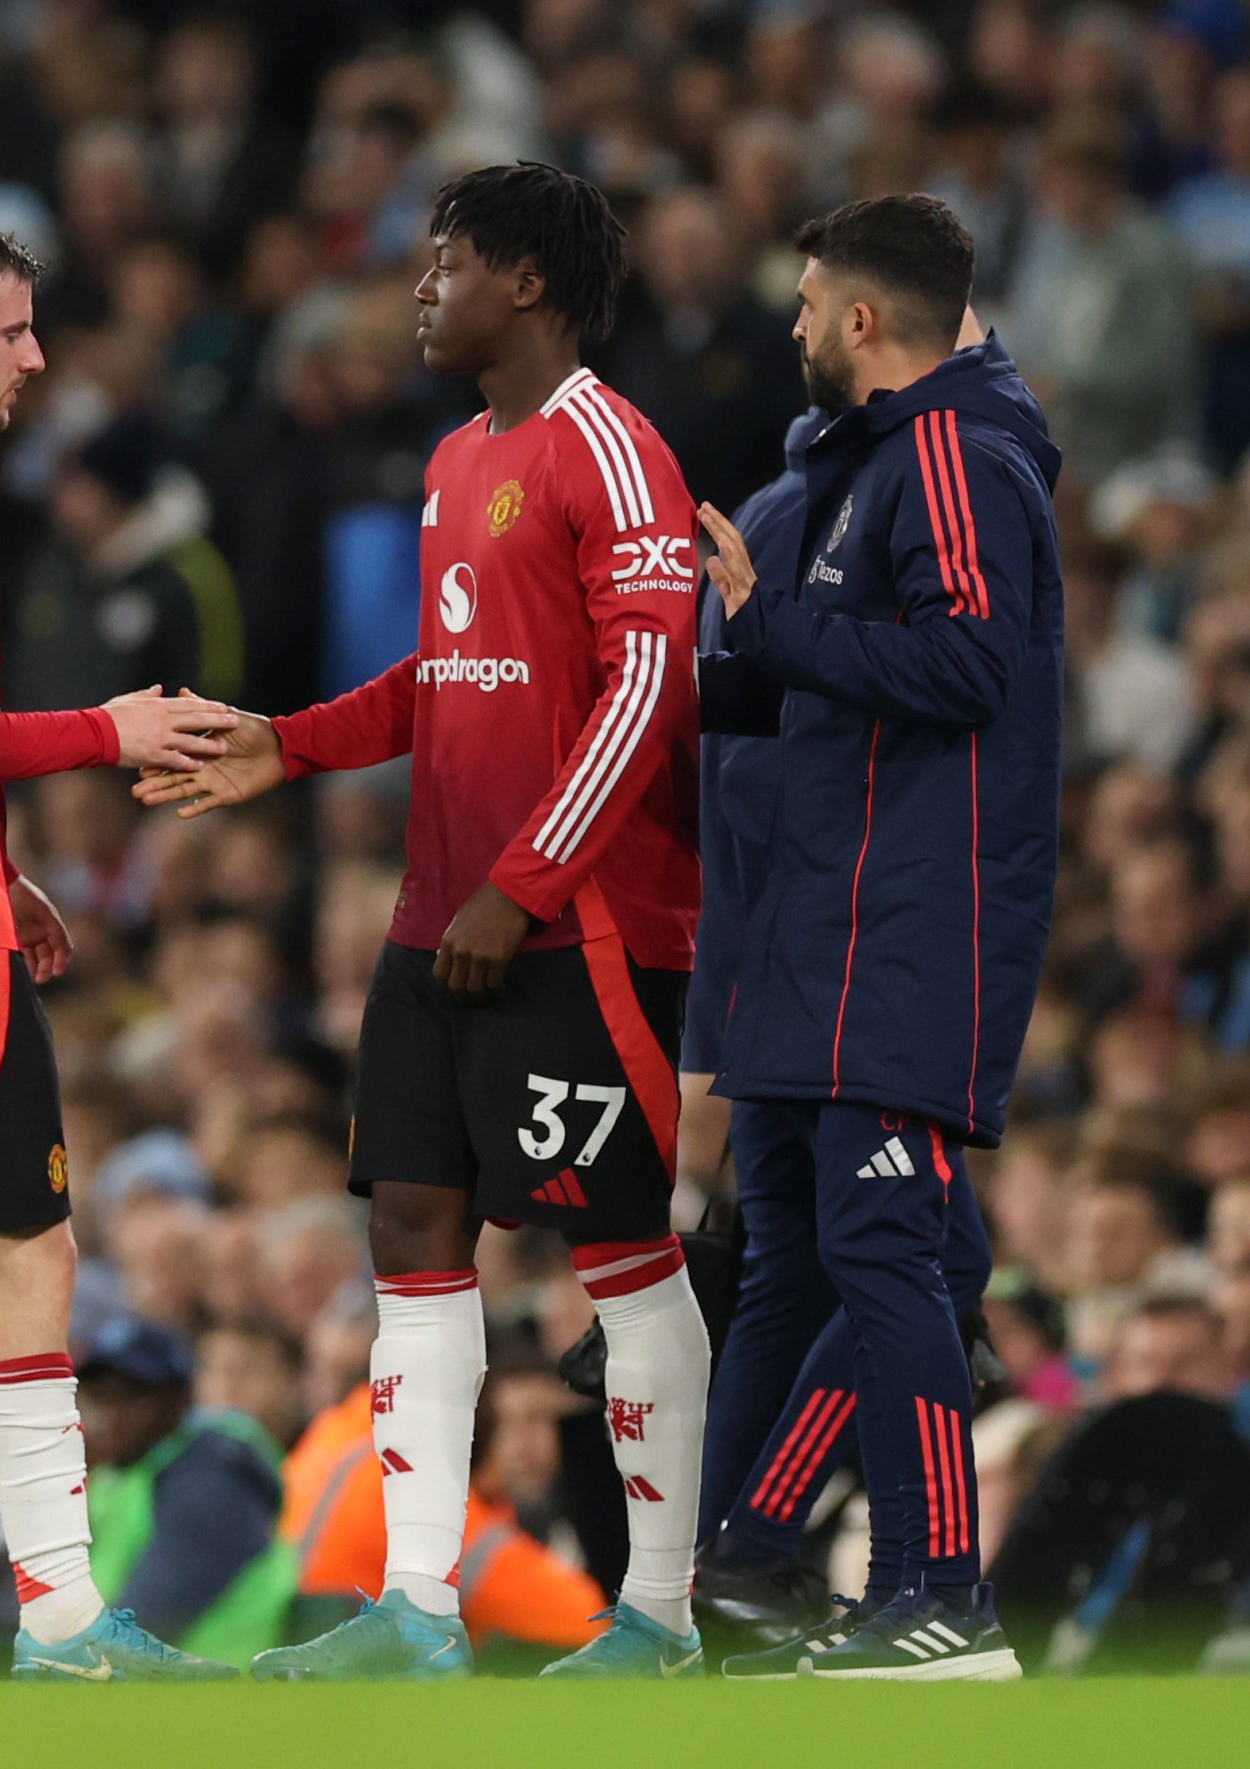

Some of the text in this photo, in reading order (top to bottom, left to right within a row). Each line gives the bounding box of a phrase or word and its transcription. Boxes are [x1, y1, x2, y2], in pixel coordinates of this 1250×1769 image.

[611, 535, 693, 580] DXC
[818, 560, 844, 585] Tezos
[614, 579, 693, 595] TECHNOLOGY
[416, 649, 530, 692] npdragon
[517, 1073, 627, 1167] 37
